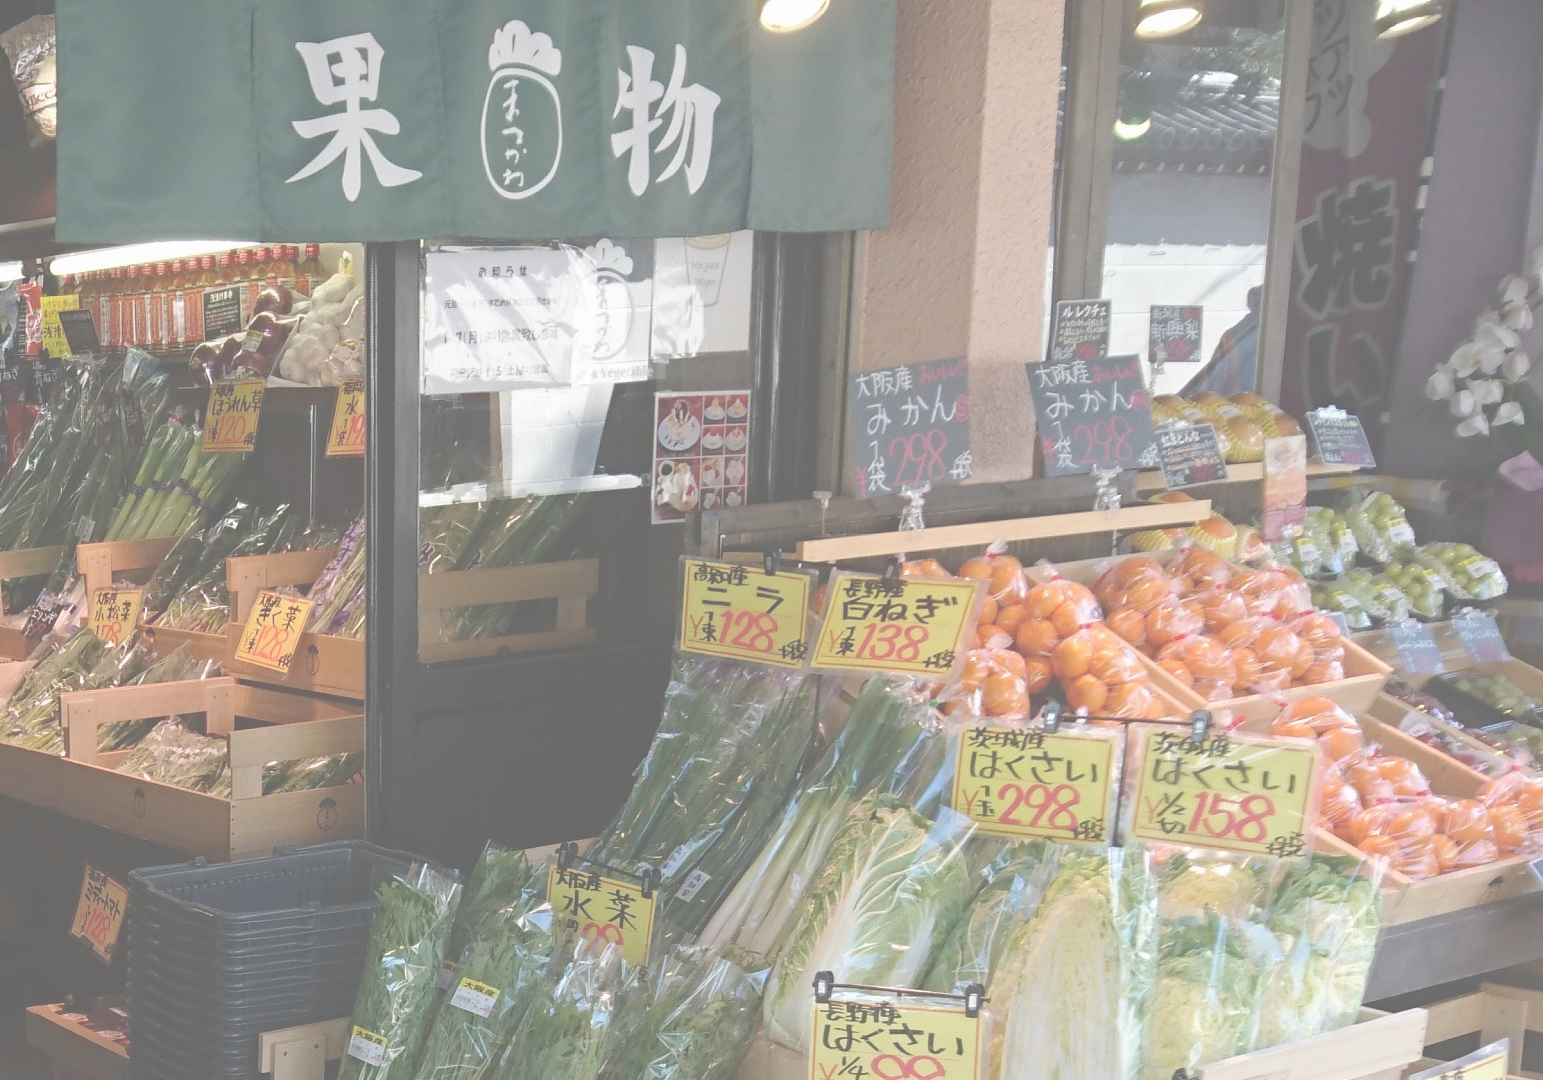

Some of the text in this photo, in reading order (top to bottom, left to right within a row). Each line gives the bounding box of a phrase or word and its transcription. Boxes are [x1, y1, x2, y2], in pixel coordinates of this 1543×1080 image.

[285, 32, 721, 202] 果 物
[501, 79, 528, 188] まつかわ
[477, 265, 528, 277] お知らせ
[856, 365, 914, 399] 大阪産
[1034, 359, 1093, 389] 大阪産
[866, 384, 957, 435] みかん
[1045, 381, 1134, 419] みかん
[216, 414, 247, 444] 120
[1074, 415, 1133, 465] 298
[888, 428, 948, 486] 298
[701, 585, 785, 616] ニラ
[842, 594, 958, 625] 白ねぎ
[253, 625, 290, 661] 128
[717, 609, 779, 655] 128
[855, 622, 930, 663] 138
[970, 750, 1098, 785] はくさい
[1151, 755, 1296, 795] はくさい
[997, 783, 1082, 831] 298
[1187, 789, 1276, 843] 158
[561, 889, 638, 931] 水菜
[822, 1022, 965, 1057] はくさい
